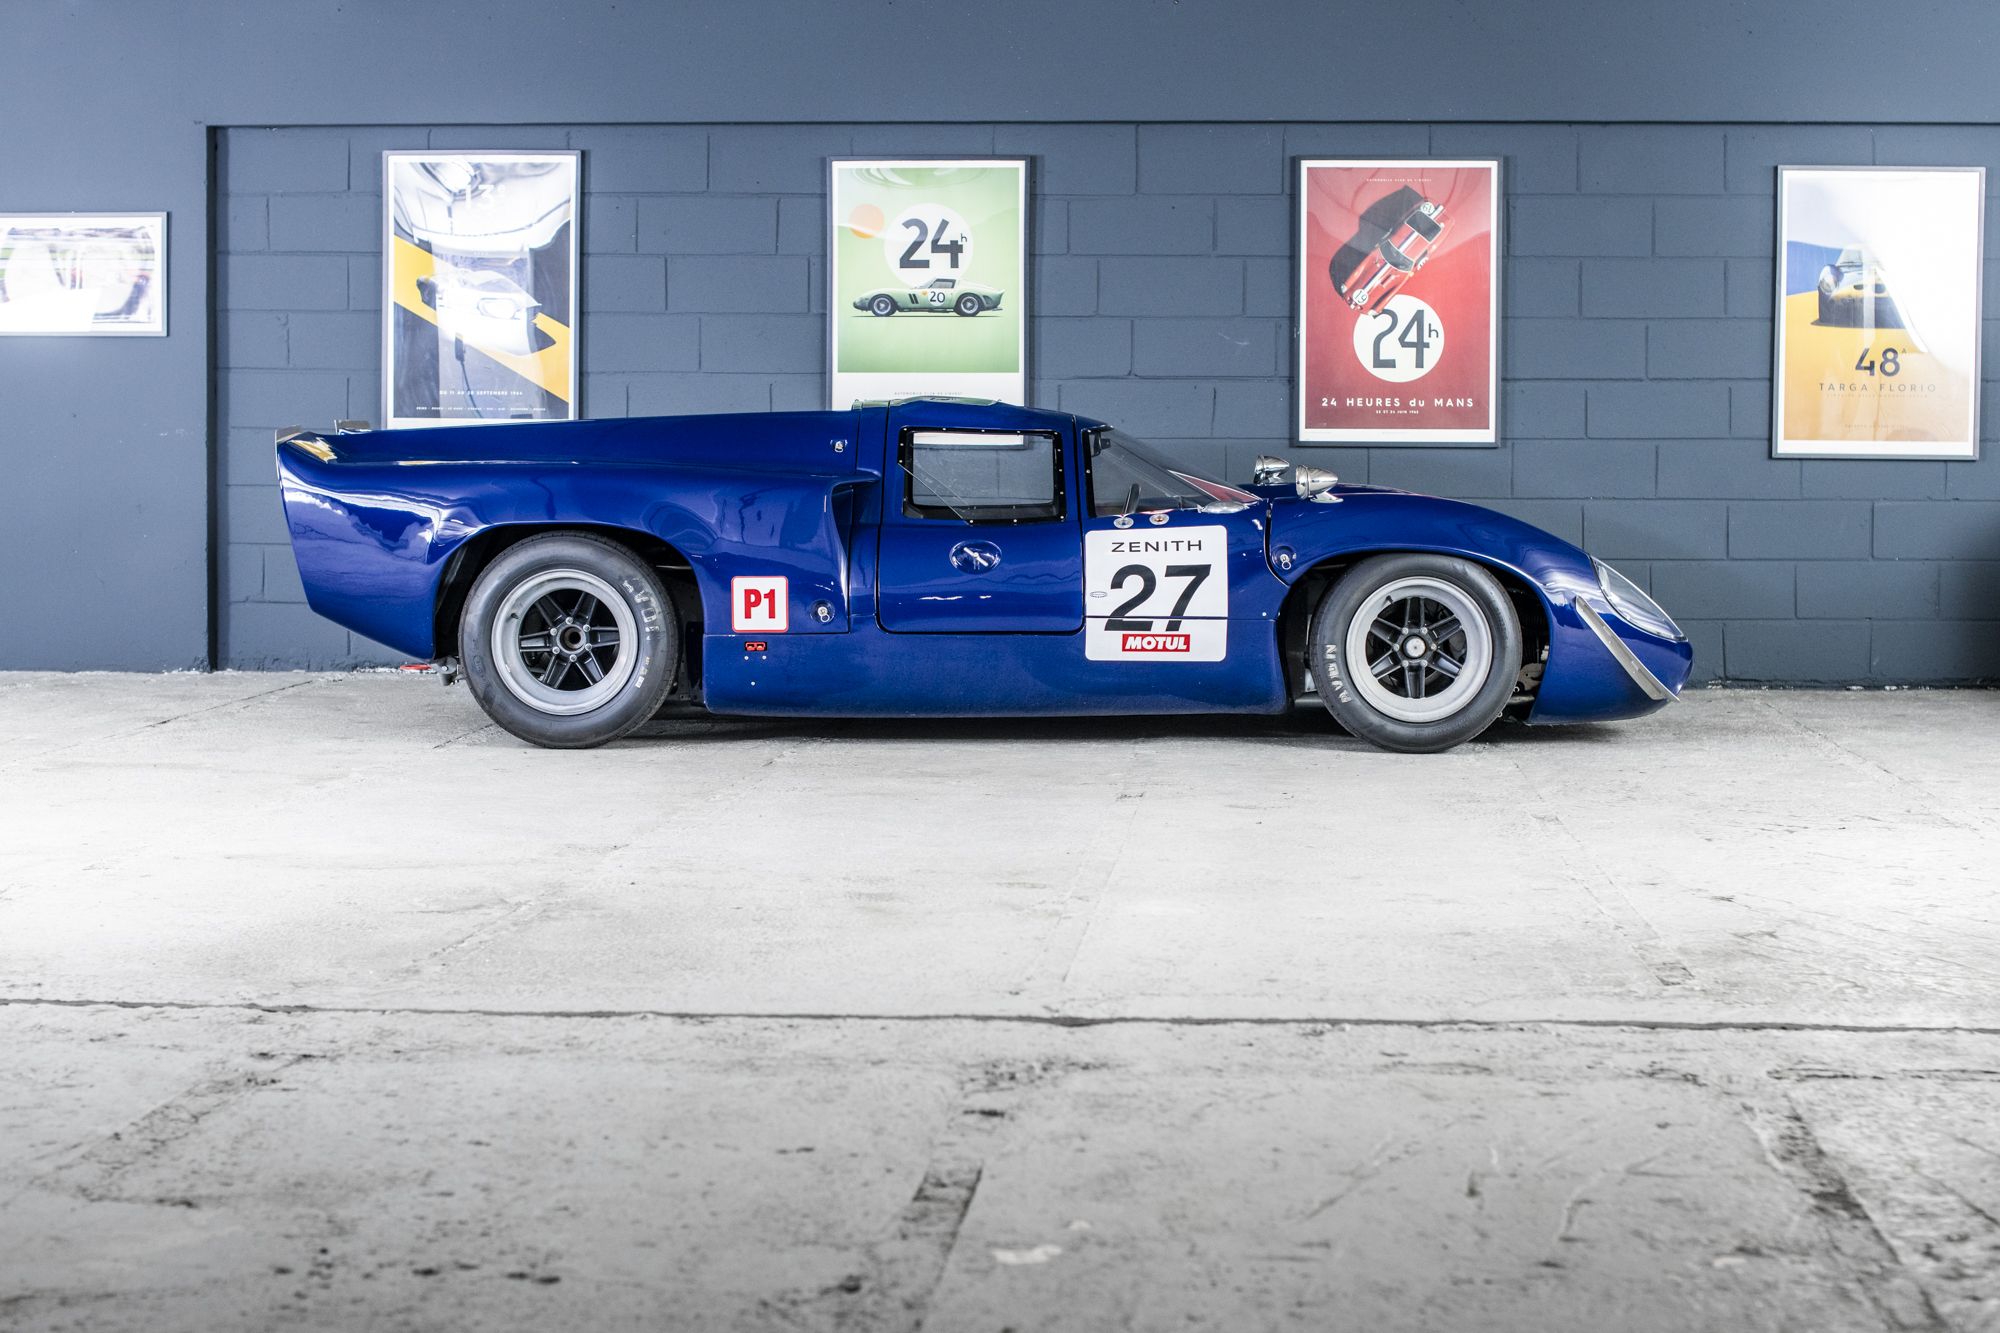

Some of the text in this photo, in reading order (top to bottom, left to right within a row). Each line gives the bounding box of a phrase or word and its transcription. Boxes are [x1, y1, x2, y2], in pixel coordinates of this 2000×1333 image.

[929, 290, 946, 304] 20
[1819, 383, 1936, 393] TARGA FLORIO
[1321, 397, 1474, 408] 24 HEURES du MANS
[1111, 539, 1202, 553] ZENITH
[744, 588, 776, 620] P1
[1104, 564, 1212, 632] 27
[1124, 636, 1188, 650] MOTUL
